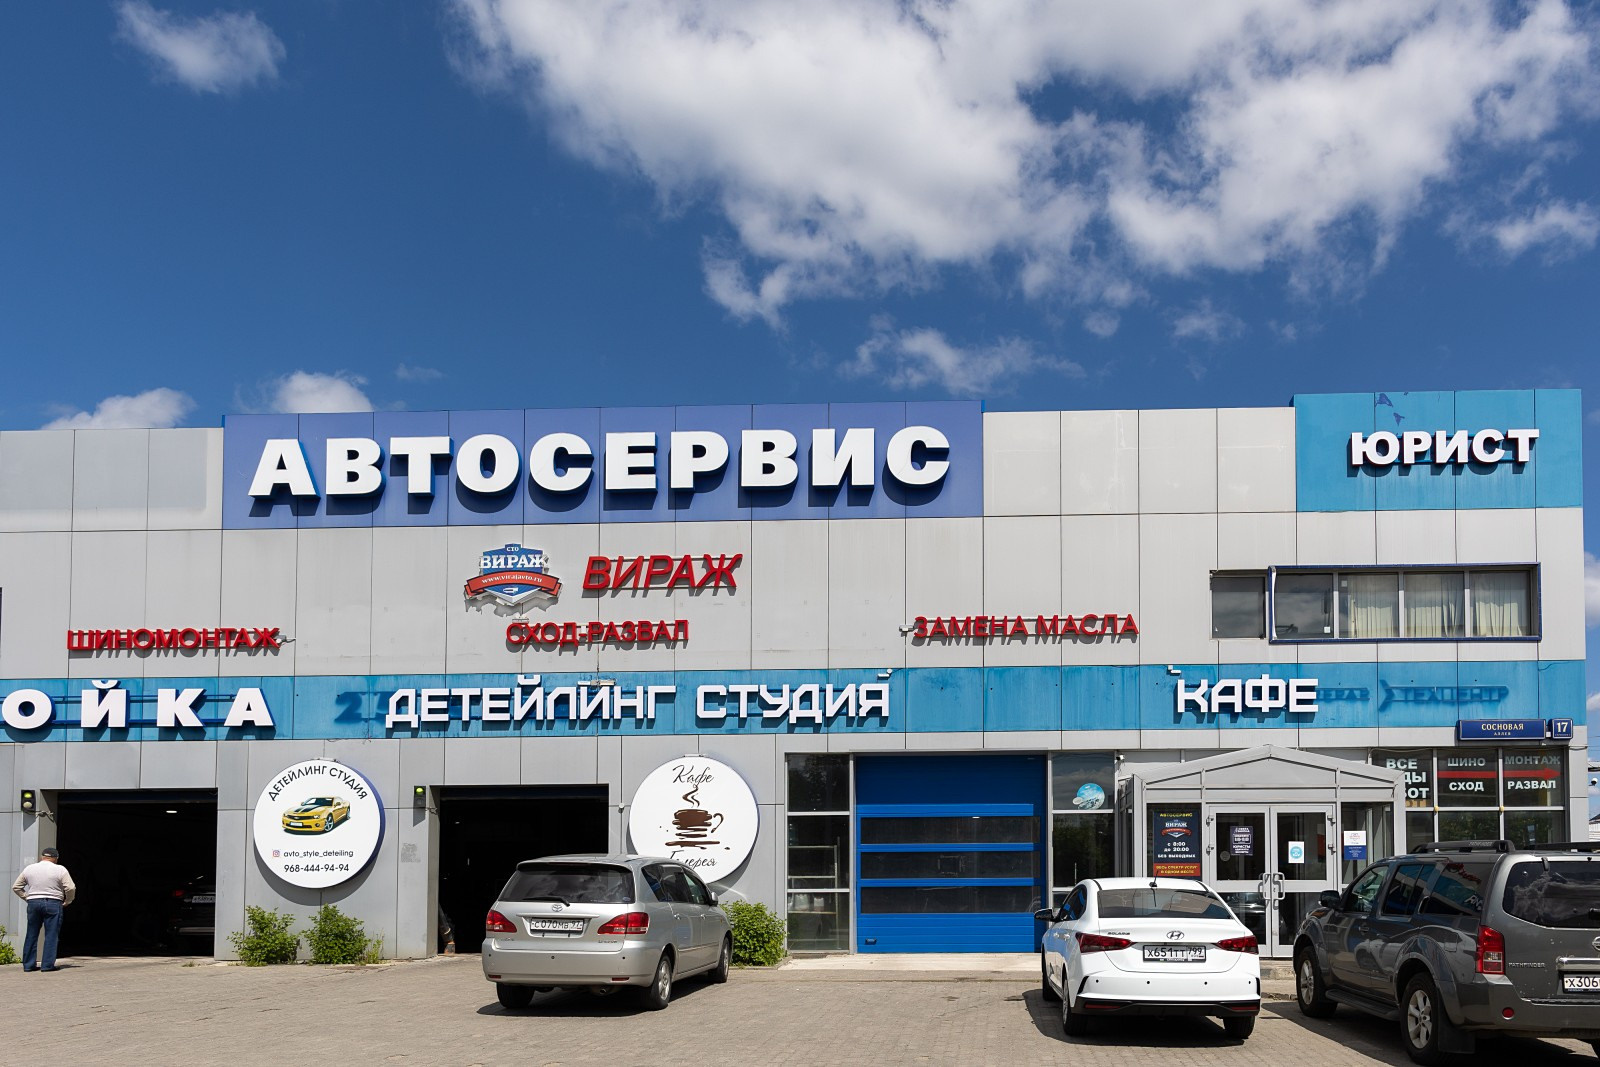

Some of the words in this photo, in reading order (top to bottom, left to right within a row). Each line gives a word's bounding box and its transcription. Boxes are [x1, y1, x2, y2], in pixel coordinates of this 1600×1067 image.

[1351, 429, 1540, 465] ЮРИСТ
[248, 426, 950, 498] АВТОСЕРВИС
[480, 553, 548, 569] ВИРАЖ
[583, 553, 743, 590] ВИРАЖ
[481, 573, 543, 584] www.virajavto.ru
[914, 615, 1029, 638] ЗАМЕНА
[1037, 613, 1140, 636] МАСЛА
[67, 627, 280, 651] ШИНОМОНТАЖ
[505, 619, 689, 647] СХОД-РАЗВАЛ
[1177, 673, 1319, 713] КАФЕ
[385, 674, 676, 728] ДЕТЕЙЛИНГ
[697, 683, 890, 724] СТУДИЯ
[1481, 723, 1524, 731] СОСНОВАЯ
[1556, 721, 1568, 732] 17
[1386, 758, 1418, 770] ВСЕ
[1447, 757, 1486, 767] ШИНО
[1504, 755, 1560, 765] МОНТАЖ
[672, 764, 714, 785] Кафе
[1404, 771, 1427, 784] ДЫ
[268, 765, 327, 801] ДЕТЕЙЛИНГ
[329, 767, 368, 800] СТУДИЯ
[1449, 781, 1484, 792] СХОД
[1507, 780, 1556, 790] РАЗВАЛ
[1405, 787, 1429, 799] ОТ
[283, 849, 354, 858] avto_style_deteiling
[671, 850, 717, 869] Герея
[283, 863, 350, 873] 968-444-94-94
[534, 919, 568, 929] С070МВ
[1147, 947, 1186, 958] Х651ТТ
[1188, 947, 1203, 955] 799
[1568, 975, 1600, 988] Х306
